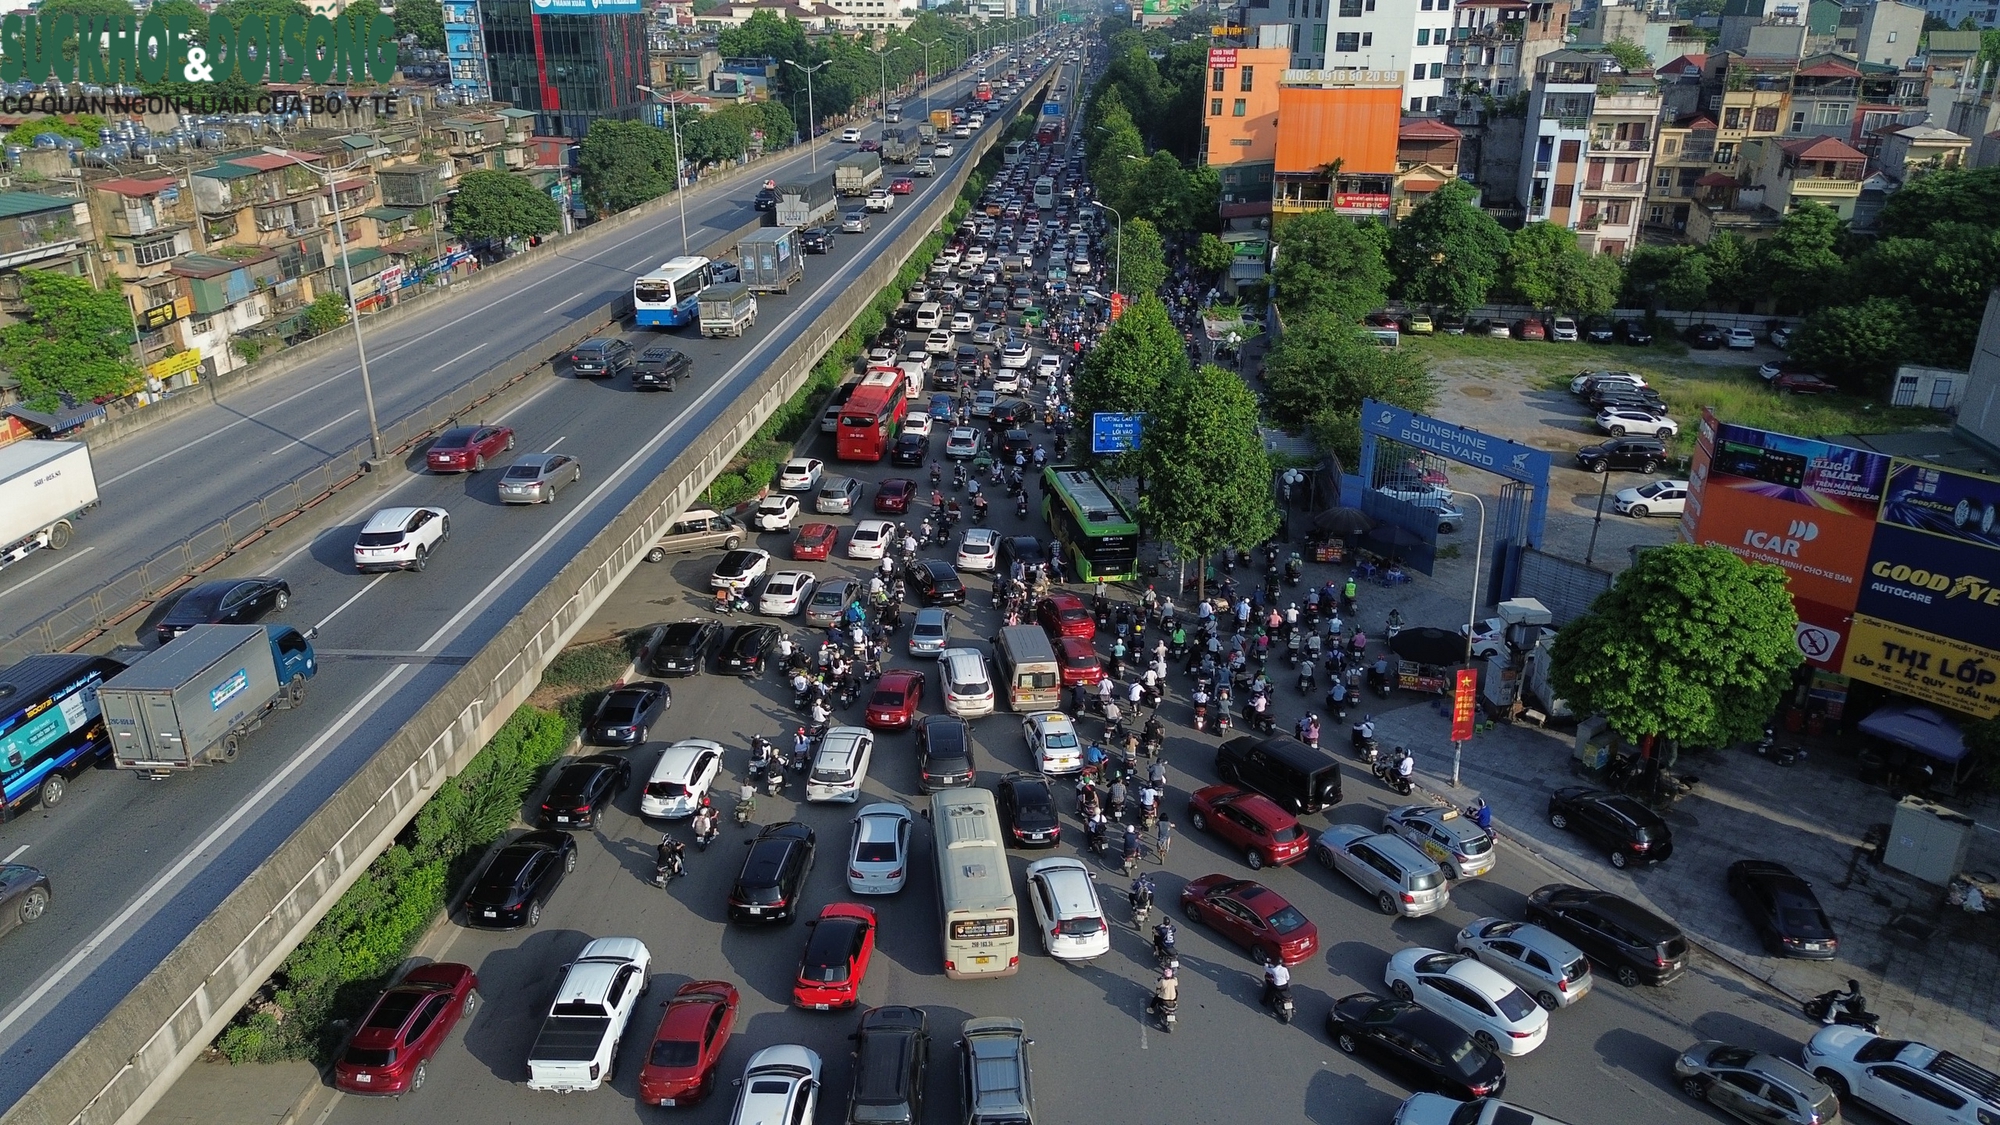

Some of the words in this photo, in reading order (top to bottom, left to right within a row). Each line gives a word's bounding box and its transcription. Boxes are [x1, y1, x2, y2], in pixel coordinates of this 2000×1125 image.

[1366, 71, 1380, 82] 20
[1383, 71, 1398, 82] 99
[1401, 429, 1494, 466] BOULEVARD
[1410, 418, 1488, 450] SUNSHINE
[1819, 468, 1862, 483] SMART
[1743, 528, 1800, 558] ICAR
[1751, 550, 1780, 566] THÔNG
[1780, 558, 1803, 572] MINH
[1803, 564, 1823, 577] CHO
[1823, 569, 1835, 579] XE
[1871, 582, 1933, 605] AUTOCARE
[1877, 662, 1893, 674] XE
[1921, 675, 1946, 689] QUY
